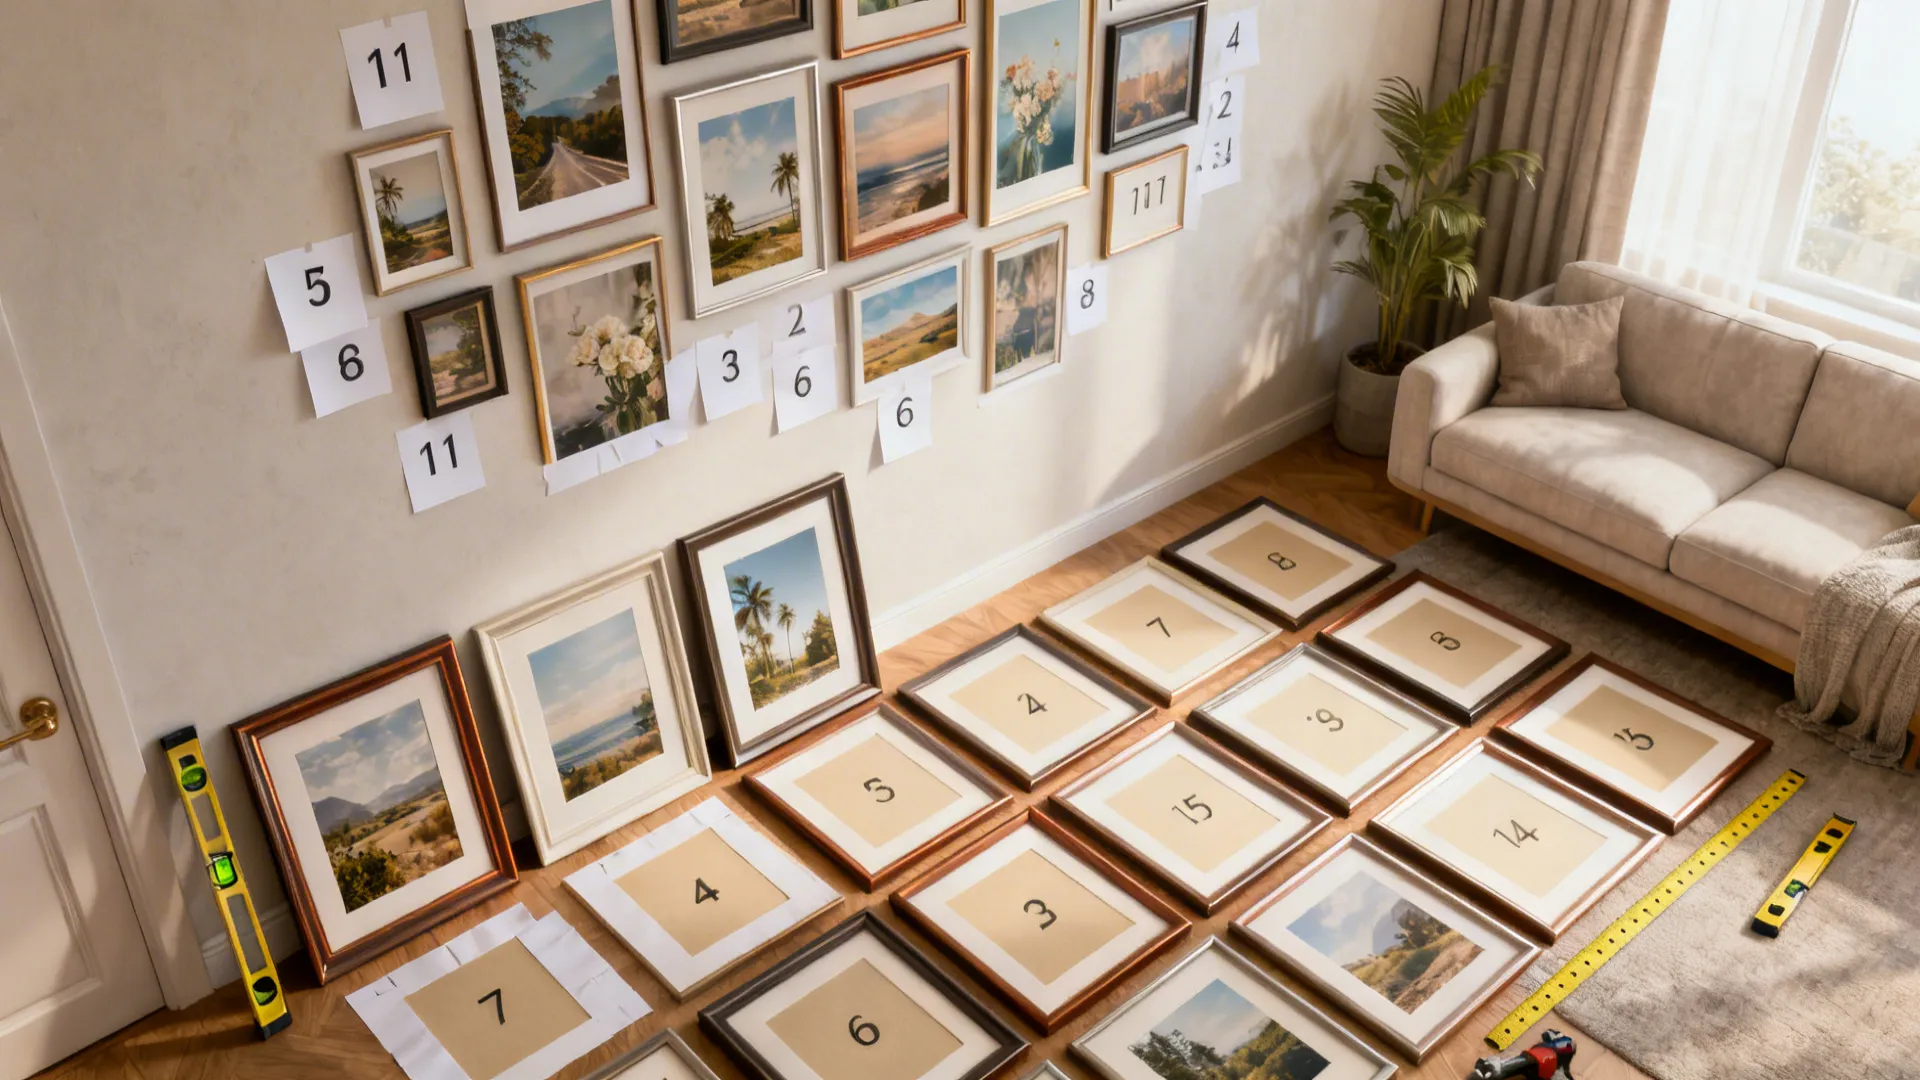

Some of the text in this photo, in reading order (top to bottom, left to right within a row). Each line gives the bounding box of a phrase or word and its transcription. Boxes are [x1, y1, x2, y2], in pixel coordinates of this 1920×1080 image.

[1226, 21, 1240, 53] 4
[367, 42, 411, 88] 11
[1217, 91, 1231, 119] 2
[305, 266, 330, 306] 5
[1081, 279, 1094, 309] 8
[788, 304, 806, 337] 2
[339, 344, 364, 381] 6
[722, 350, 739, 382] 3
[795, 366, 811, 397] 6
[897, 397, 913, 427] 6
[420, 434, 457, 476] 11
[1146, 617, 1170, 637] 7
[1172, 794, 1212, 824] 15
[1493, 820, 1539, 848] 14
[695, 878, 719, 904] 4
[1024, 899, 1057, 930] 3
[478, 988, 505, 1025] 7
[849, 1015, 880, 1046] 6
